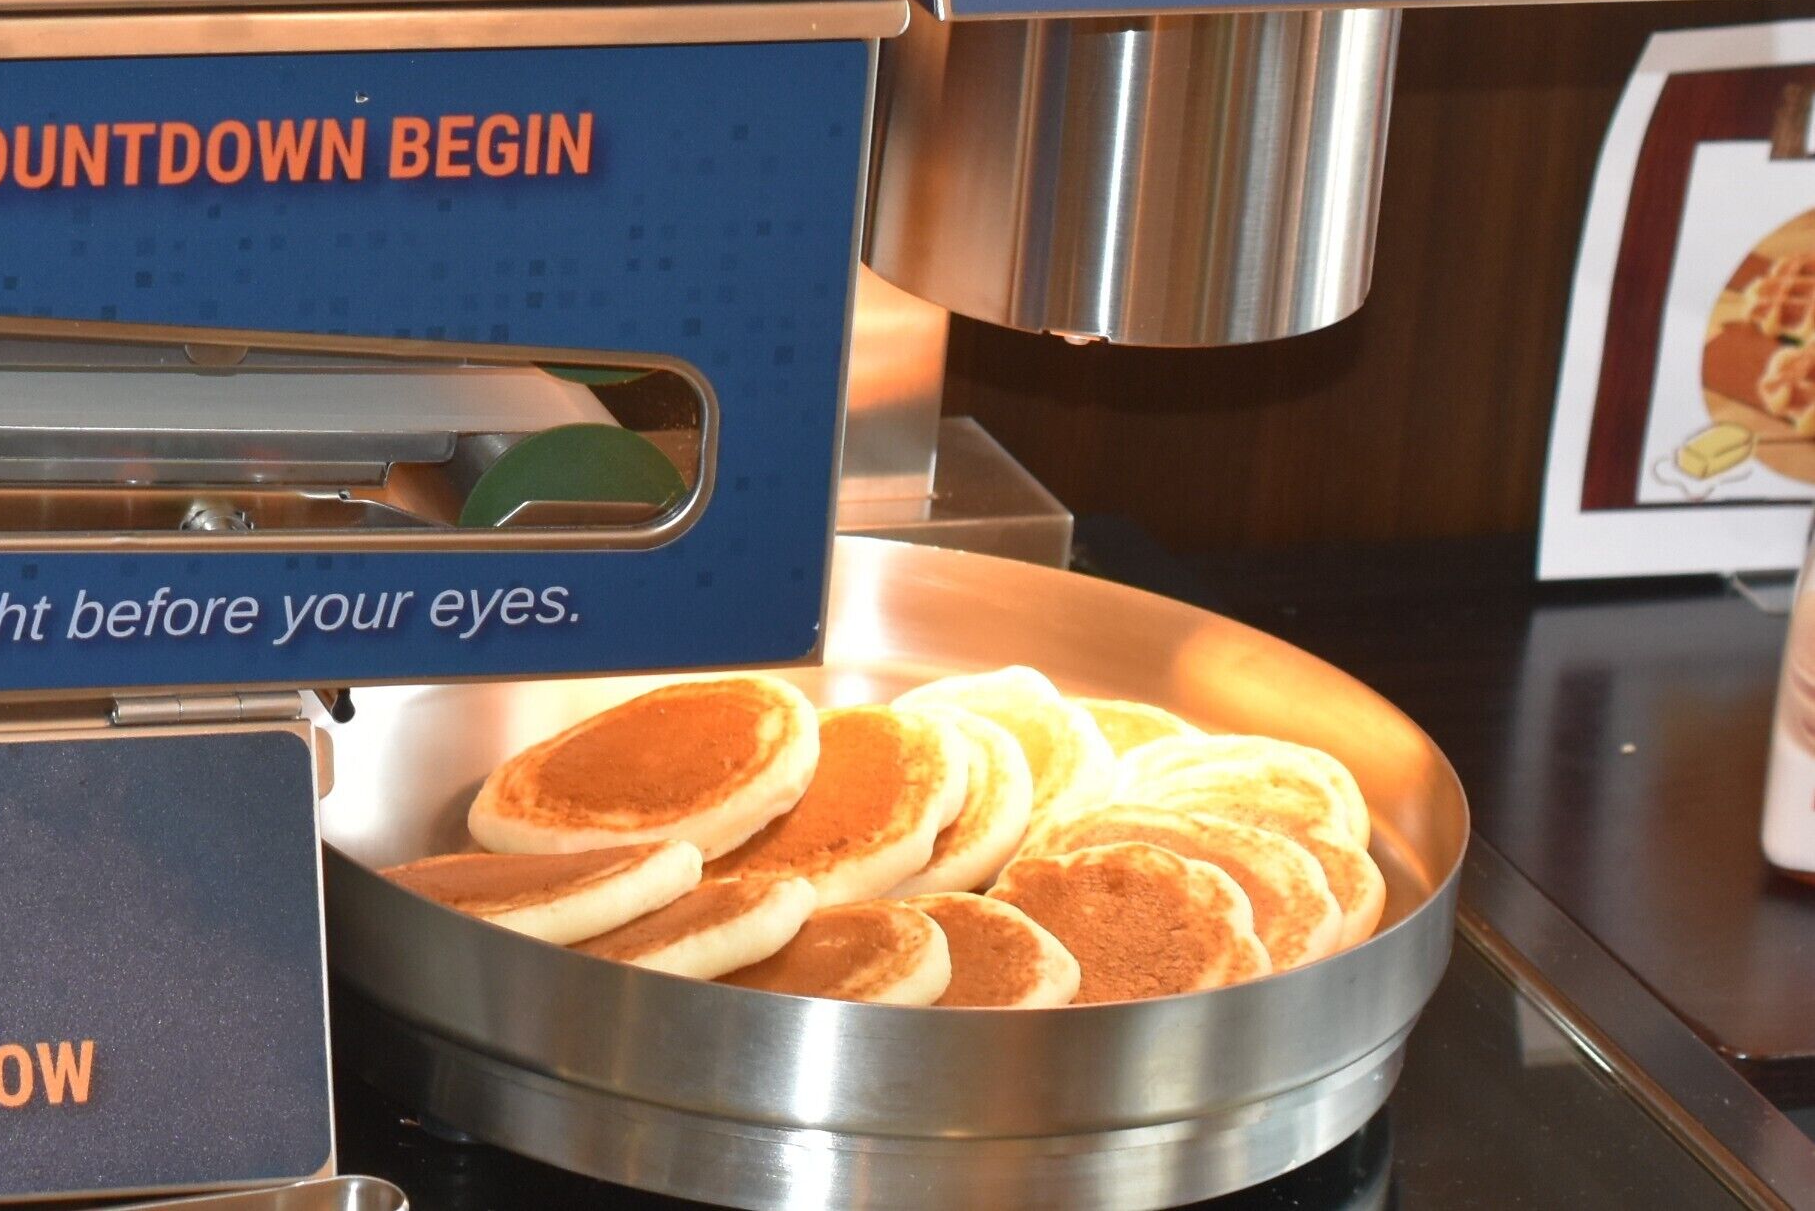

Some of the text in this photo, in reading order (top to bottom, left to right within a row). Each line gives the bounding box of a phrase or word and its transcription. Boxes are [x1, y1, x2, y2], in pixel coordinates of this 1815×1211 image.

[389, 112, 595, 180] BEGIN
[67, 586, 261, 641] before
[273, 588, 413, 646] your
[428, 584, 583, 640] eyes.
